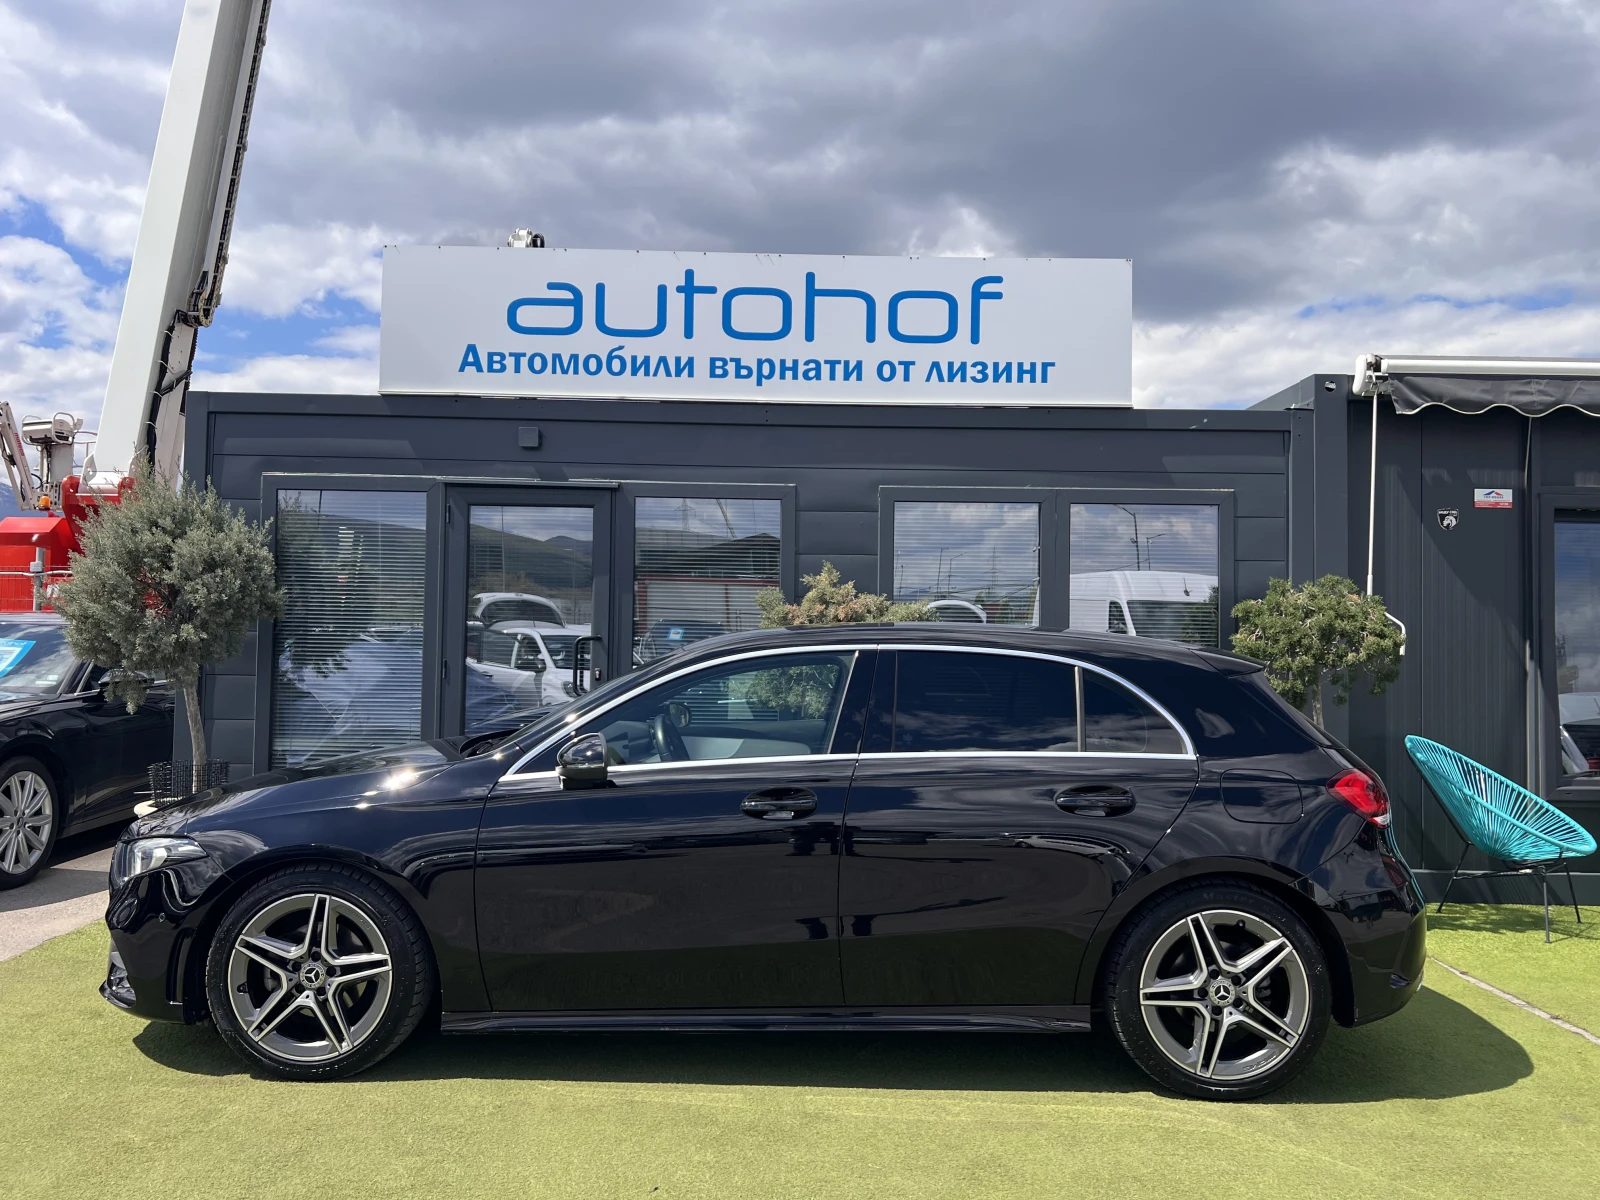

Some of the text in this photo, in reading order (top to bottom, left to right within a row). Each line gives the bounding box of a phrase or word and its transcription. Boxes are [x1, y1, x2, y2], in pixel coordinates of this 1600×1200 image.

[507, 269, 1004, 345] autohof
[459, 344, 1056, 386] Автомобили върнати от лизинг
